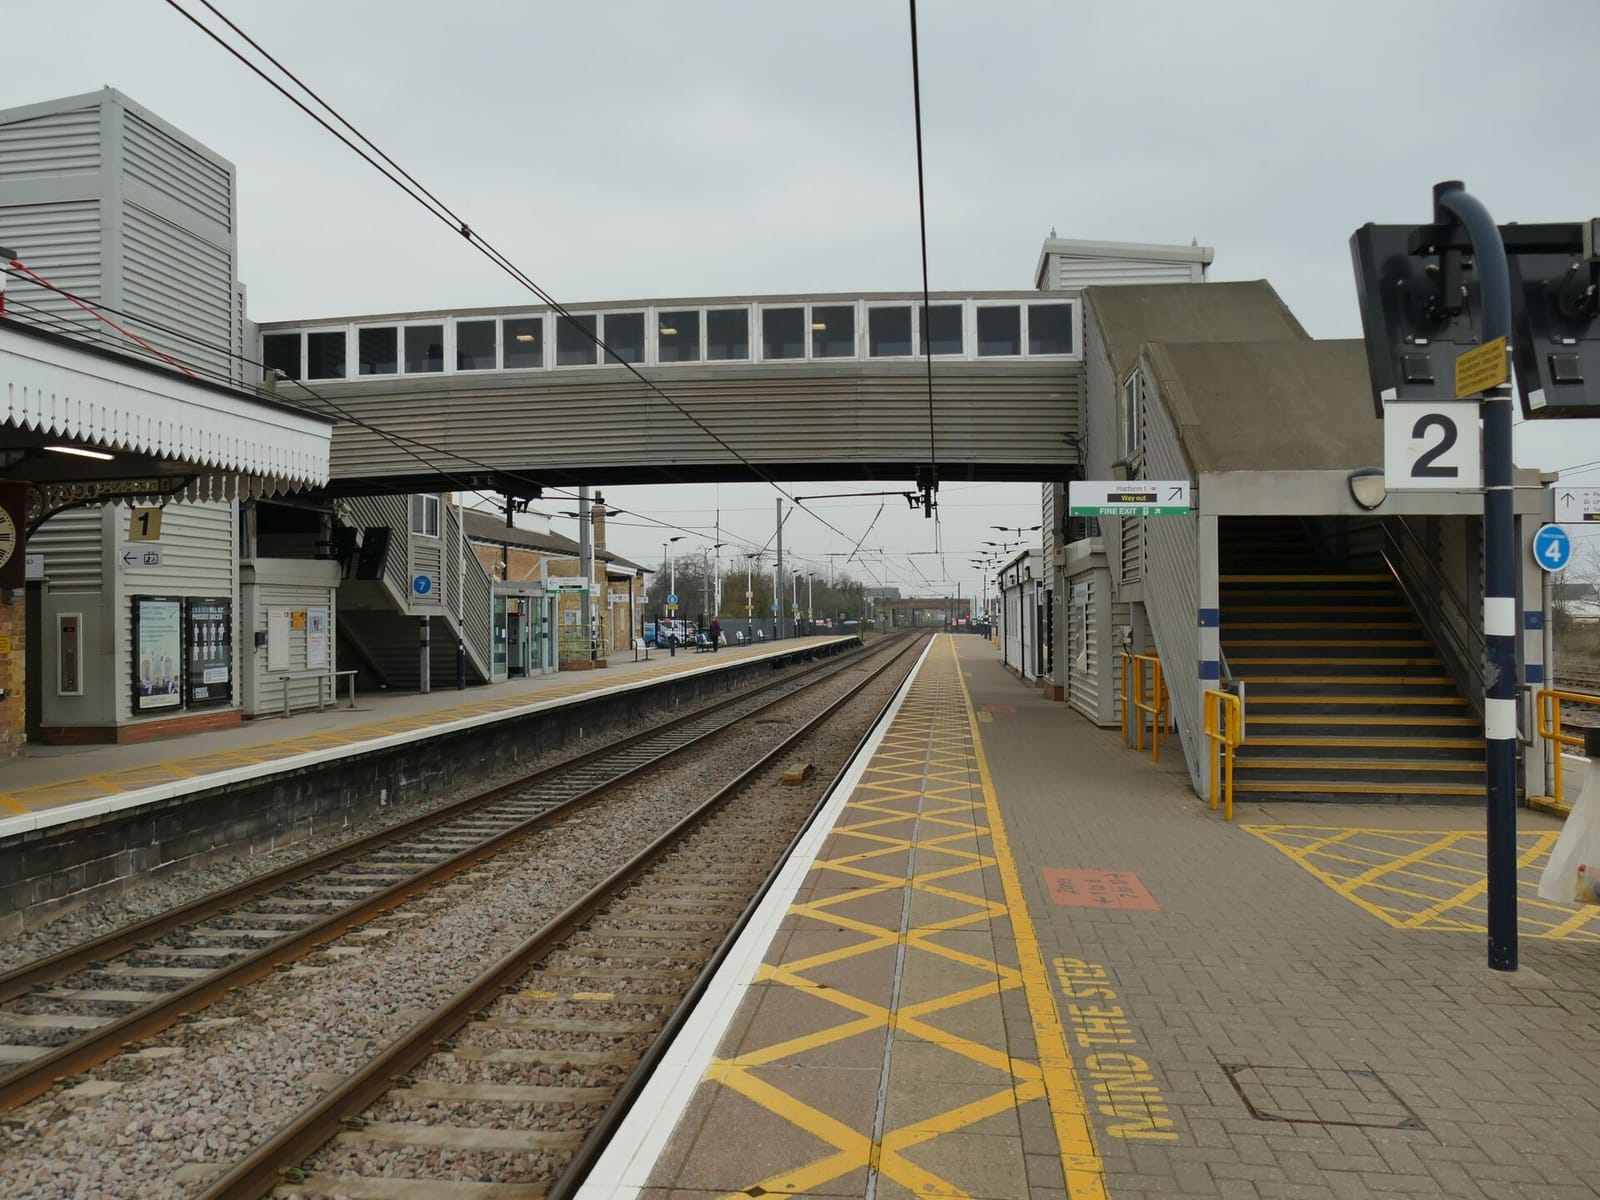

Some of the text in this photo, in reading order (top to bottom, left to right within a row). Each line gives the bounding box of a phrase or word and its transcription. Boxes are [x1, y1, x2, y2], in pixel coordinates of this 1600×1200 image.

[1410, 413, 1458, 477] 2
[138, 512, 149, 536] 1
[1544, 539, 1561, 562] 4
[418, 581, 426, 591] 7
[1052, 957, 1180, 1140] MIND THE STEP
